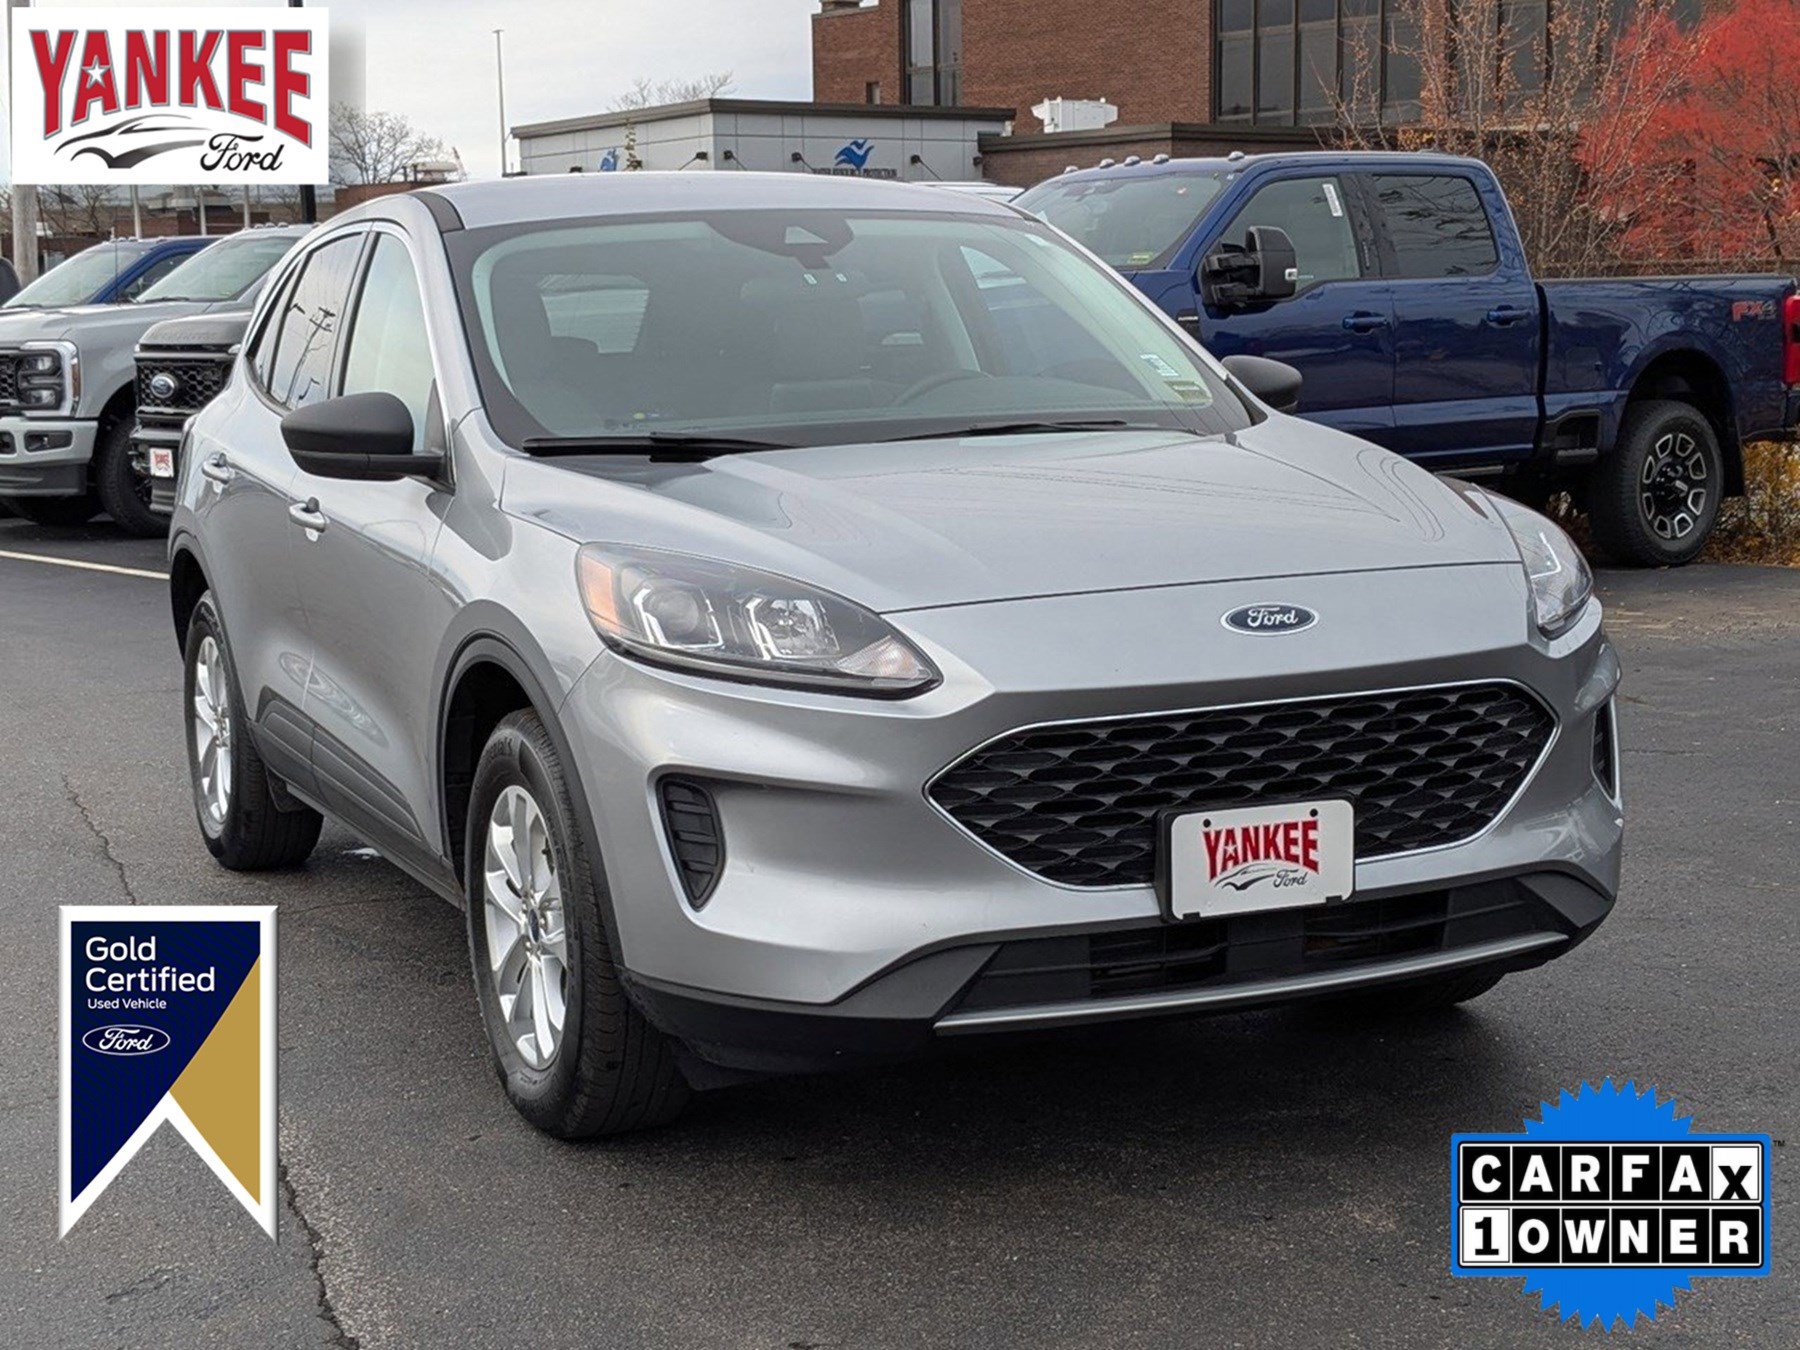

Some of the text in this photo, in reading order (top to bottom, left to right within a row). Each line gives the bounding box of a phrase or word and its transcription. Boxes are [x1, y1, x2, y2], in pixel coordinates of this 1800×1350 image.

[1247, 606, 1299, 627] Ford
[1202, 819, 1320, 883] YANKEE
[1273, 868, 1308, 889] Ford
